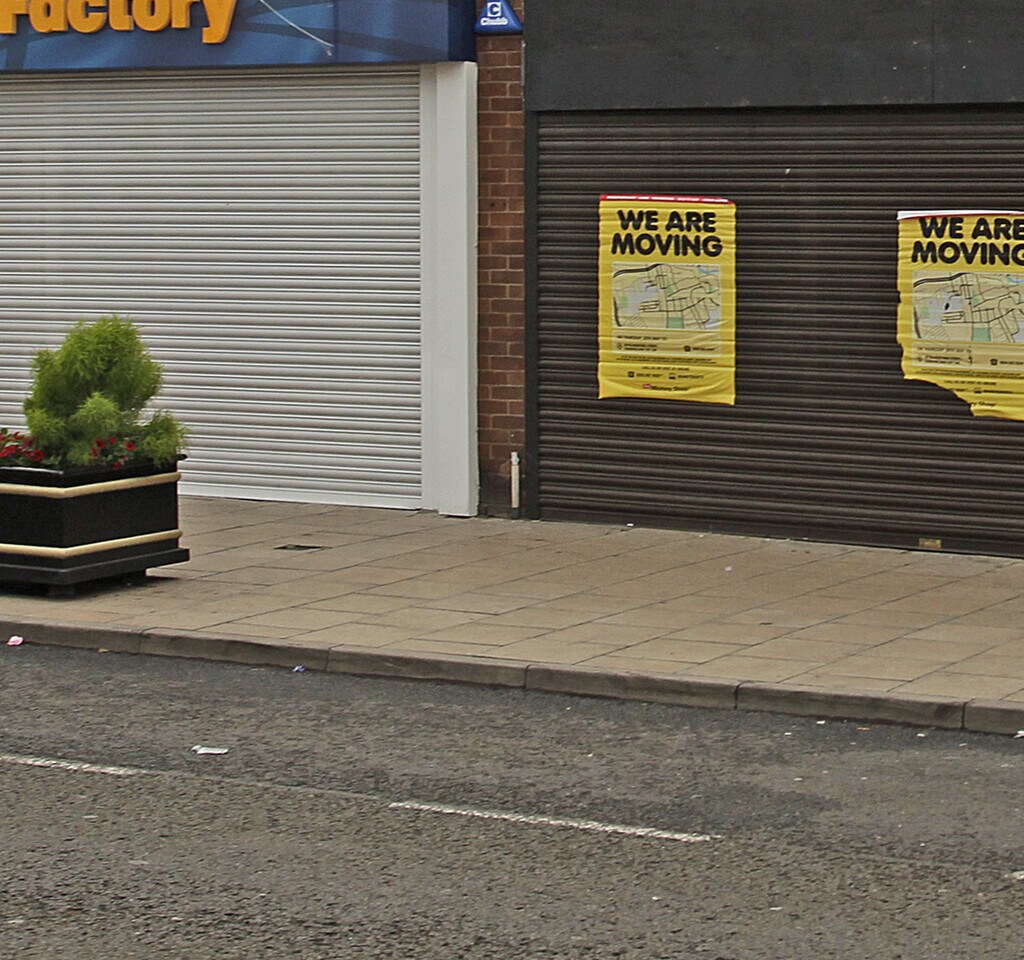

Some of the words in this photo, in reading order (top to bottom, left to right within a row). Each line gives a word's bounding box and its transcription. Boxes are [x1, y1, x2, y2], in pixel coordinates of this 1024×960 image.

[617, 209, 659, 231] WE
[665, 211, 717, 233] ARE
[918, 217, 965, 239] WE
[611, 232, 724, 258] MOVING
